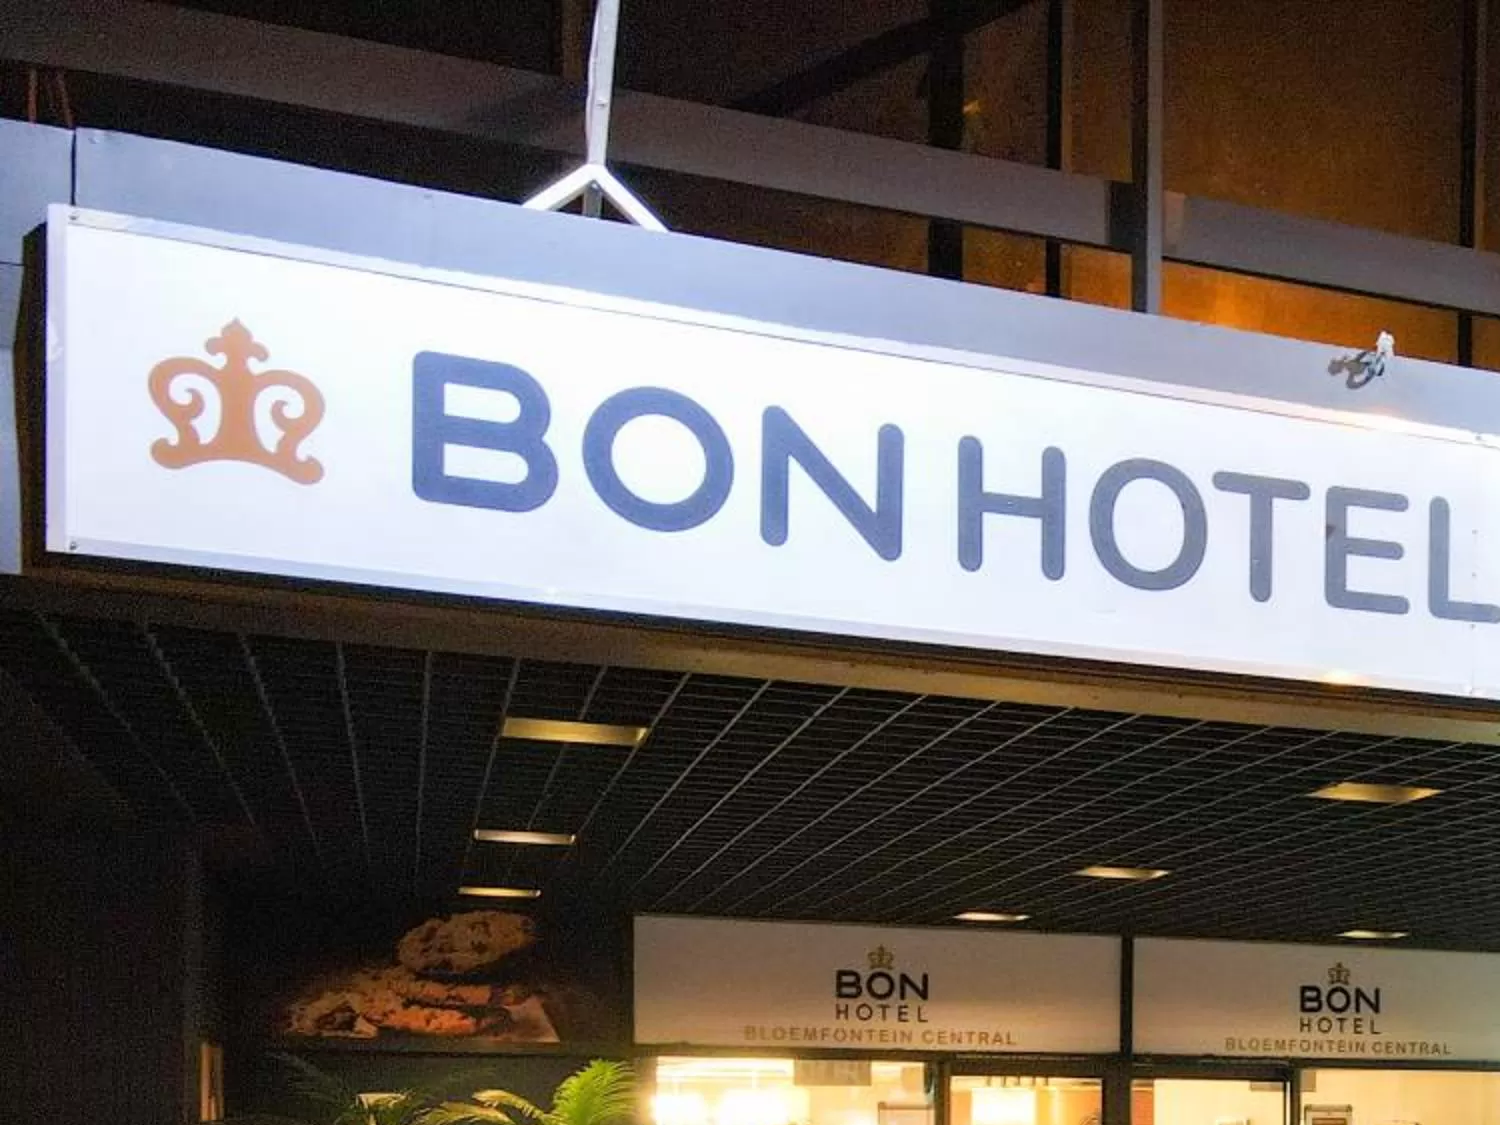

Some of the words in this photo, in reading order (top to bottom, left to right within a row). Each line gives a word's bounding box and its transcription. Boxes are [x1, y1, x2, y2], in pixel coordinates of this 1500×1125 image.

[411, 350, 905, 562] BON
[835, 969, 929, 1001] BON
[1299, 985, 1382, 1014] BON
[835, 1003, 929, 1023] HOTEL
[743, 1025, 912, 1044] BLOEMFONTEIN
[921, 1030, 1016, 1046] CENTRAL
[1299, 1017, 1383, 1035] HOTEL
[1225, 1037, 1366, 1054] BLOEMFONTEIN
[1371, 1041, 1453, 1056] CENTRAL
